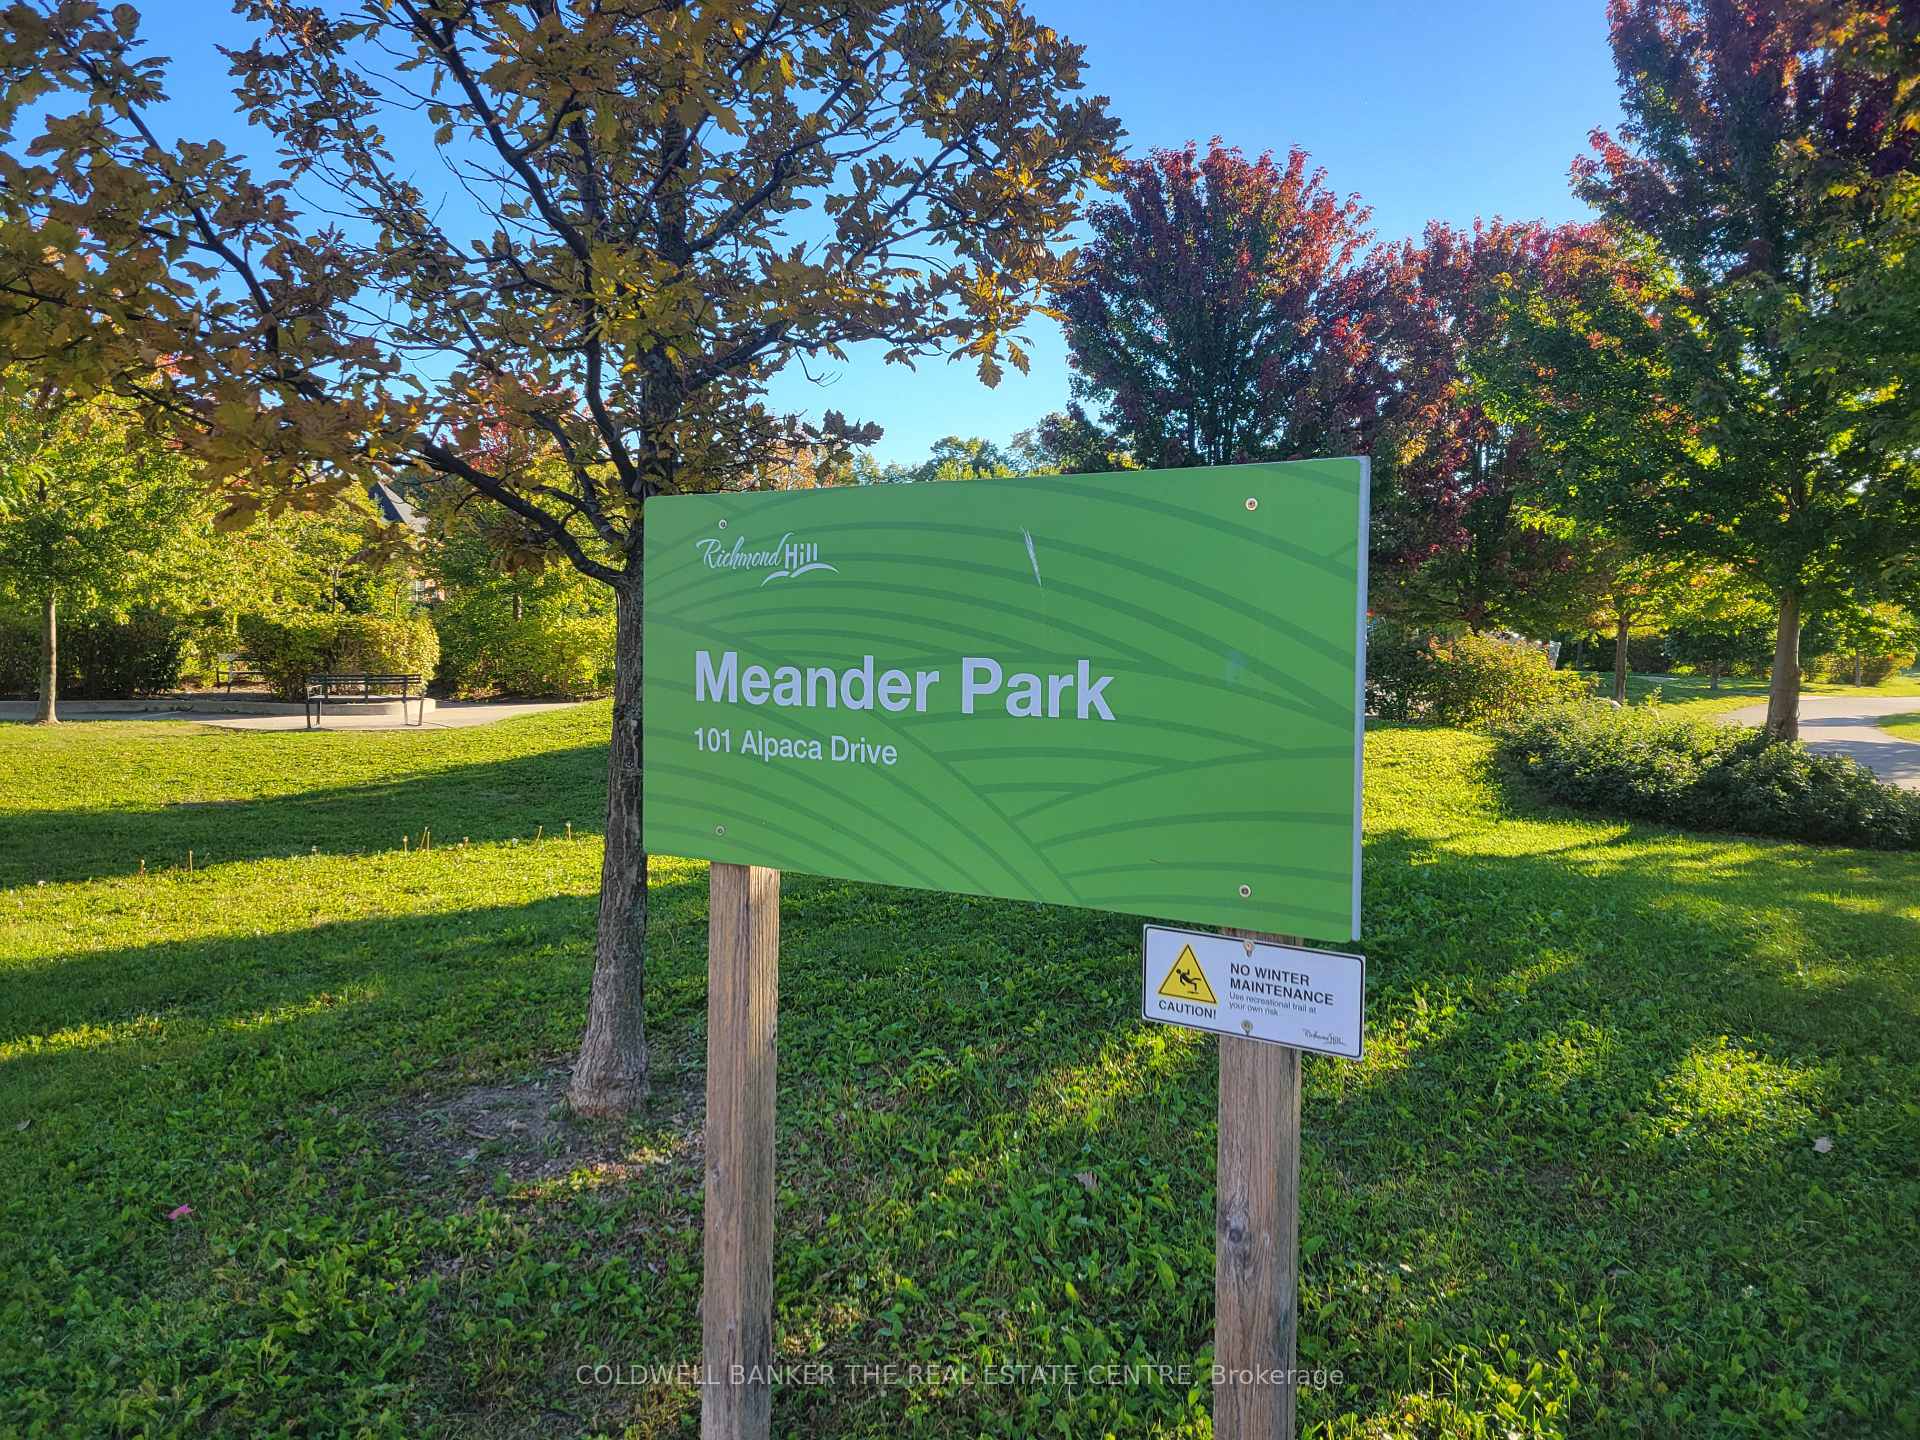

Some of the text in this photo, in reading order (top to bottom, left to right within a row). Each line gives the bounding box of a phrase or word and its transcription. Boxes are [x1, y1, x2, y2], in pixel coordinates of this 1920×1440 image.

[696, 532, 818, 570] Richmond Hill
[695, 650, 1116, 720] Meander Park
[694, 727, 898, 765] 101 Alpaca Drive
[1230, 962, 1310, 986] NO WINTER
[1229, 991, 1245, 1001] Use
[1246, 995, 1291, 1009] recreational
[1292, 1003, 1307, 1012] trail
[1230, 977, 1335, 1006] MAINTENANCE
[1158, 1000, 1217, 1019] CAUTION!
[1229, 1001, 1245, 1011] your
[1247, 1005, 1263, 1014] own
